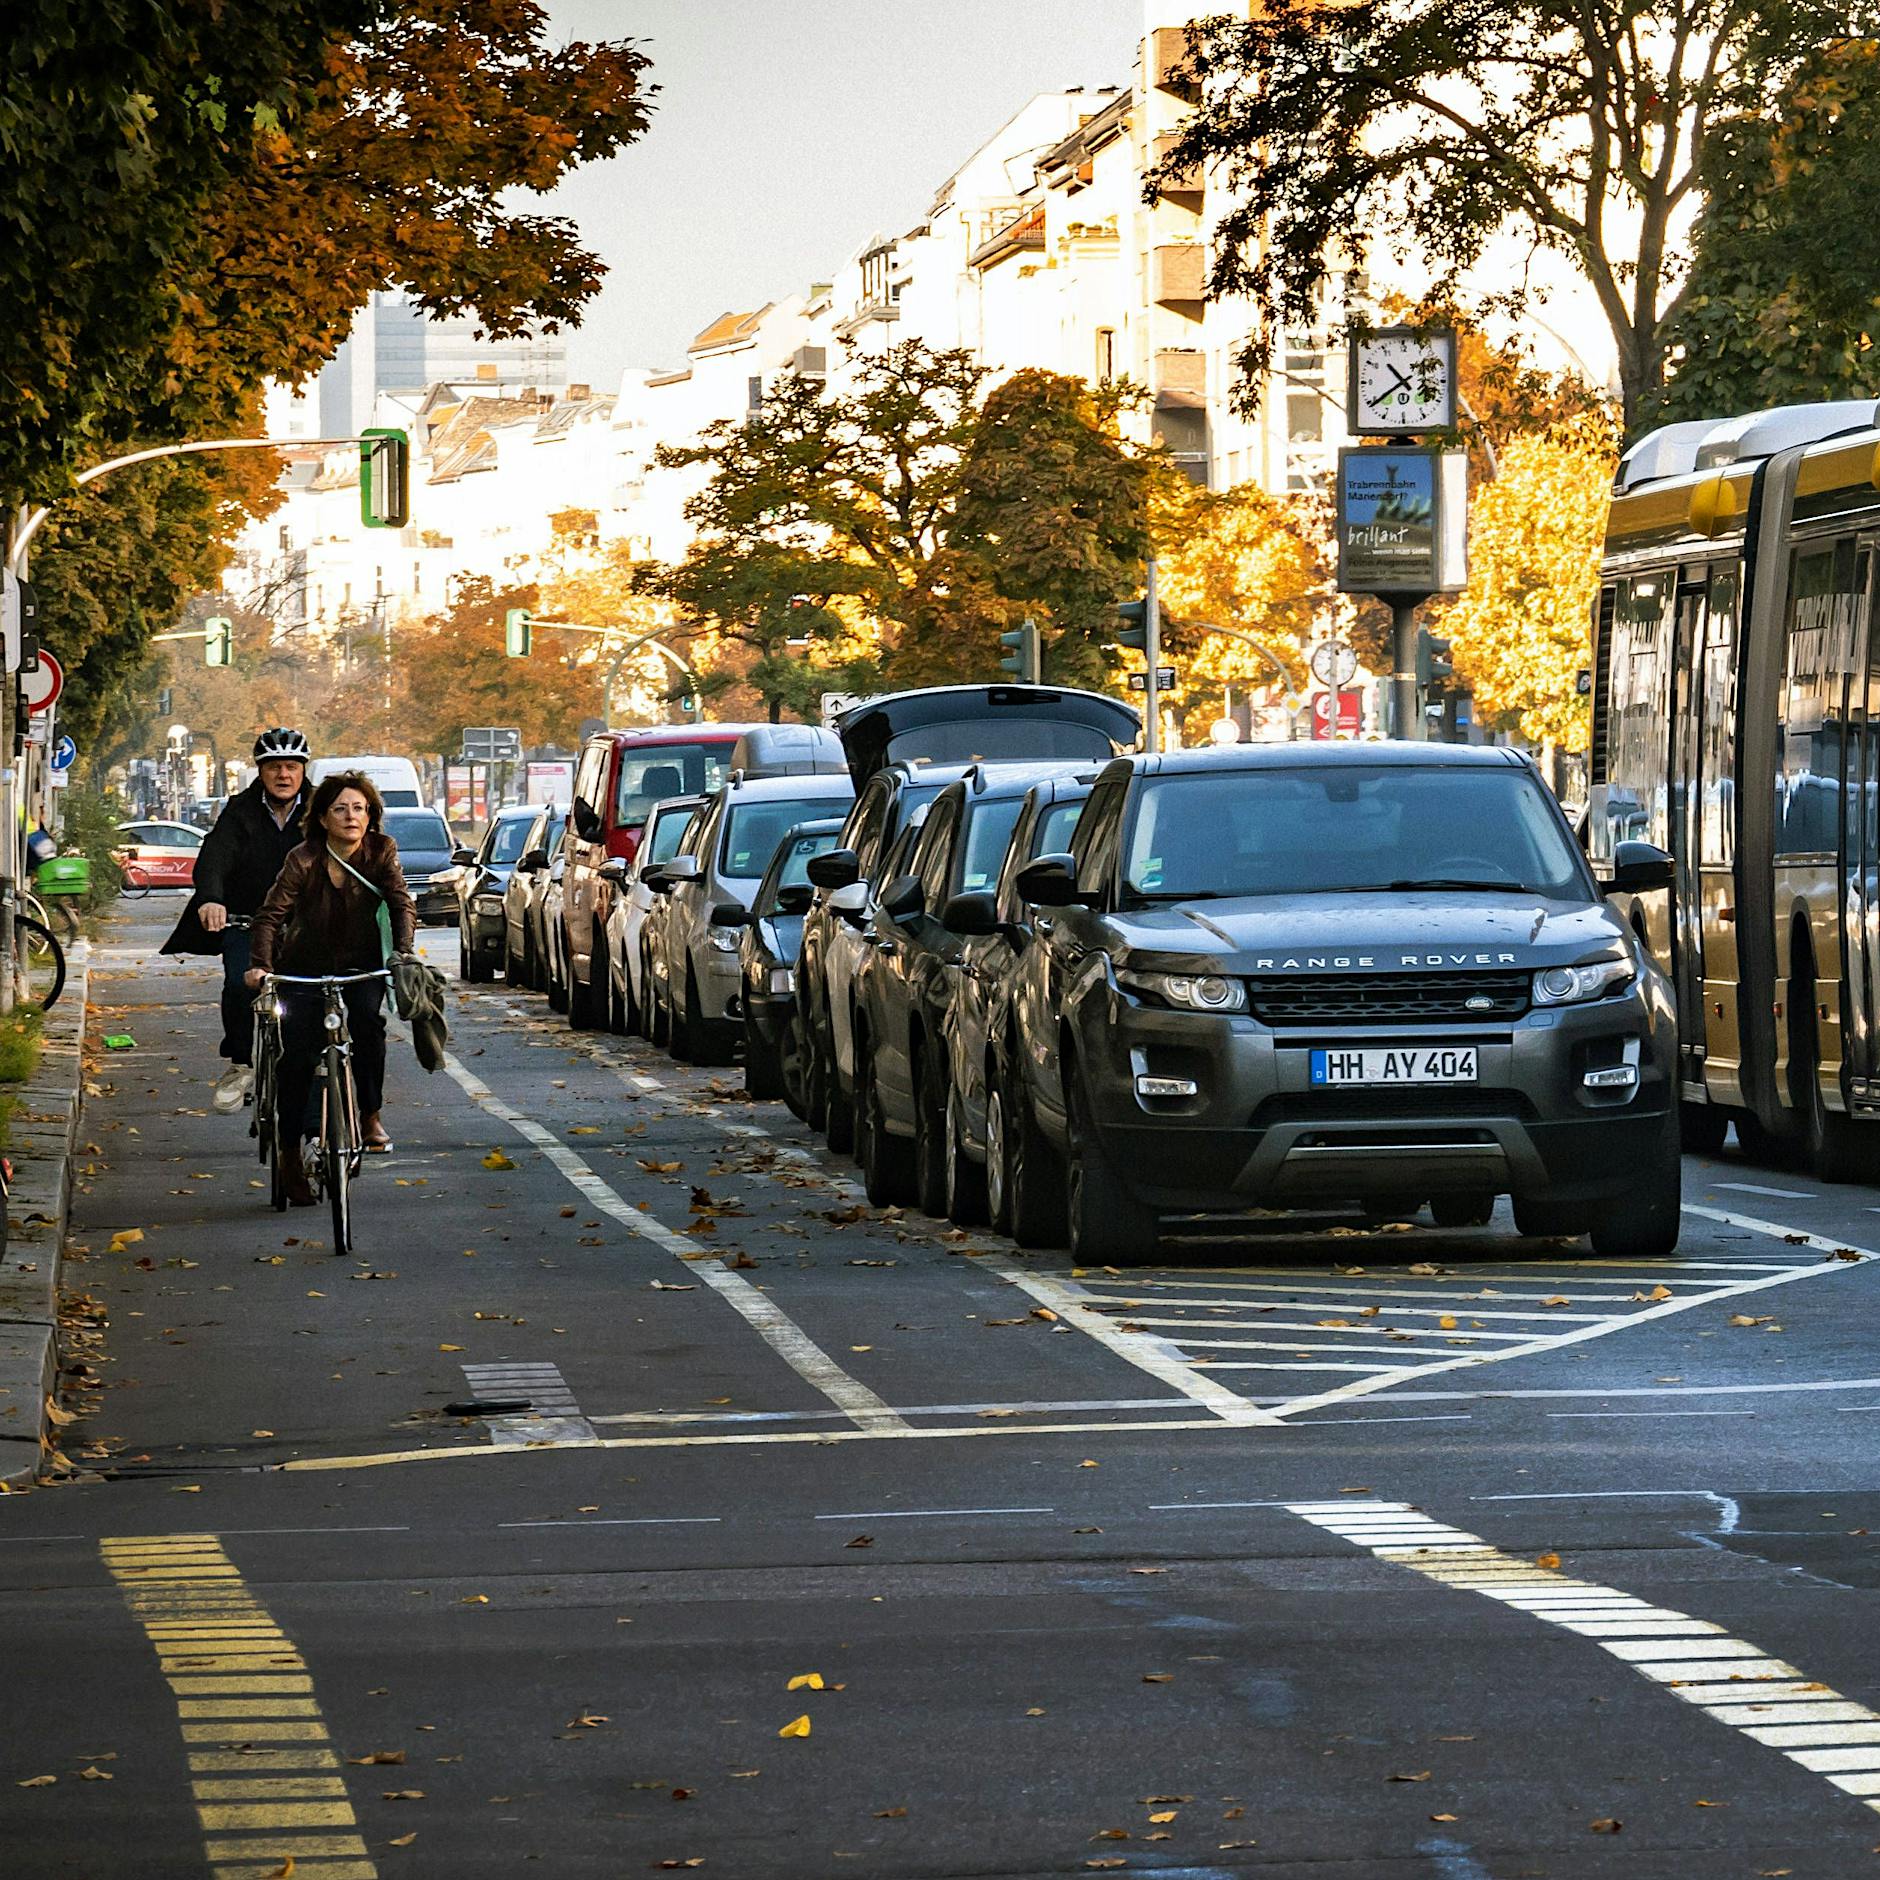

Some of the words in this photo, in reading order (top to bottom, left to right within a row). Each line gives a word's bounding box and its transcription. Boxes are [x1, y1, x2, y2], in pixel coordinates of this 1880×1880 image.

[1348, 480, 1416, 490] Trabrennbahn
[1348, 491, 1409, 502] Marienrf?
[1347, 525, 1409, 548] brillant
[1257, 957, 1374, 969] RANGE
[1401, 953, 1516, 966] ROVER
[1328, 1053, 1364, 1080] HH
[1383, 1052, 1417, 1079] AY
[1424, 1051, 1474, 1078] 404
[1315, 1070, 1323, 1080] D
